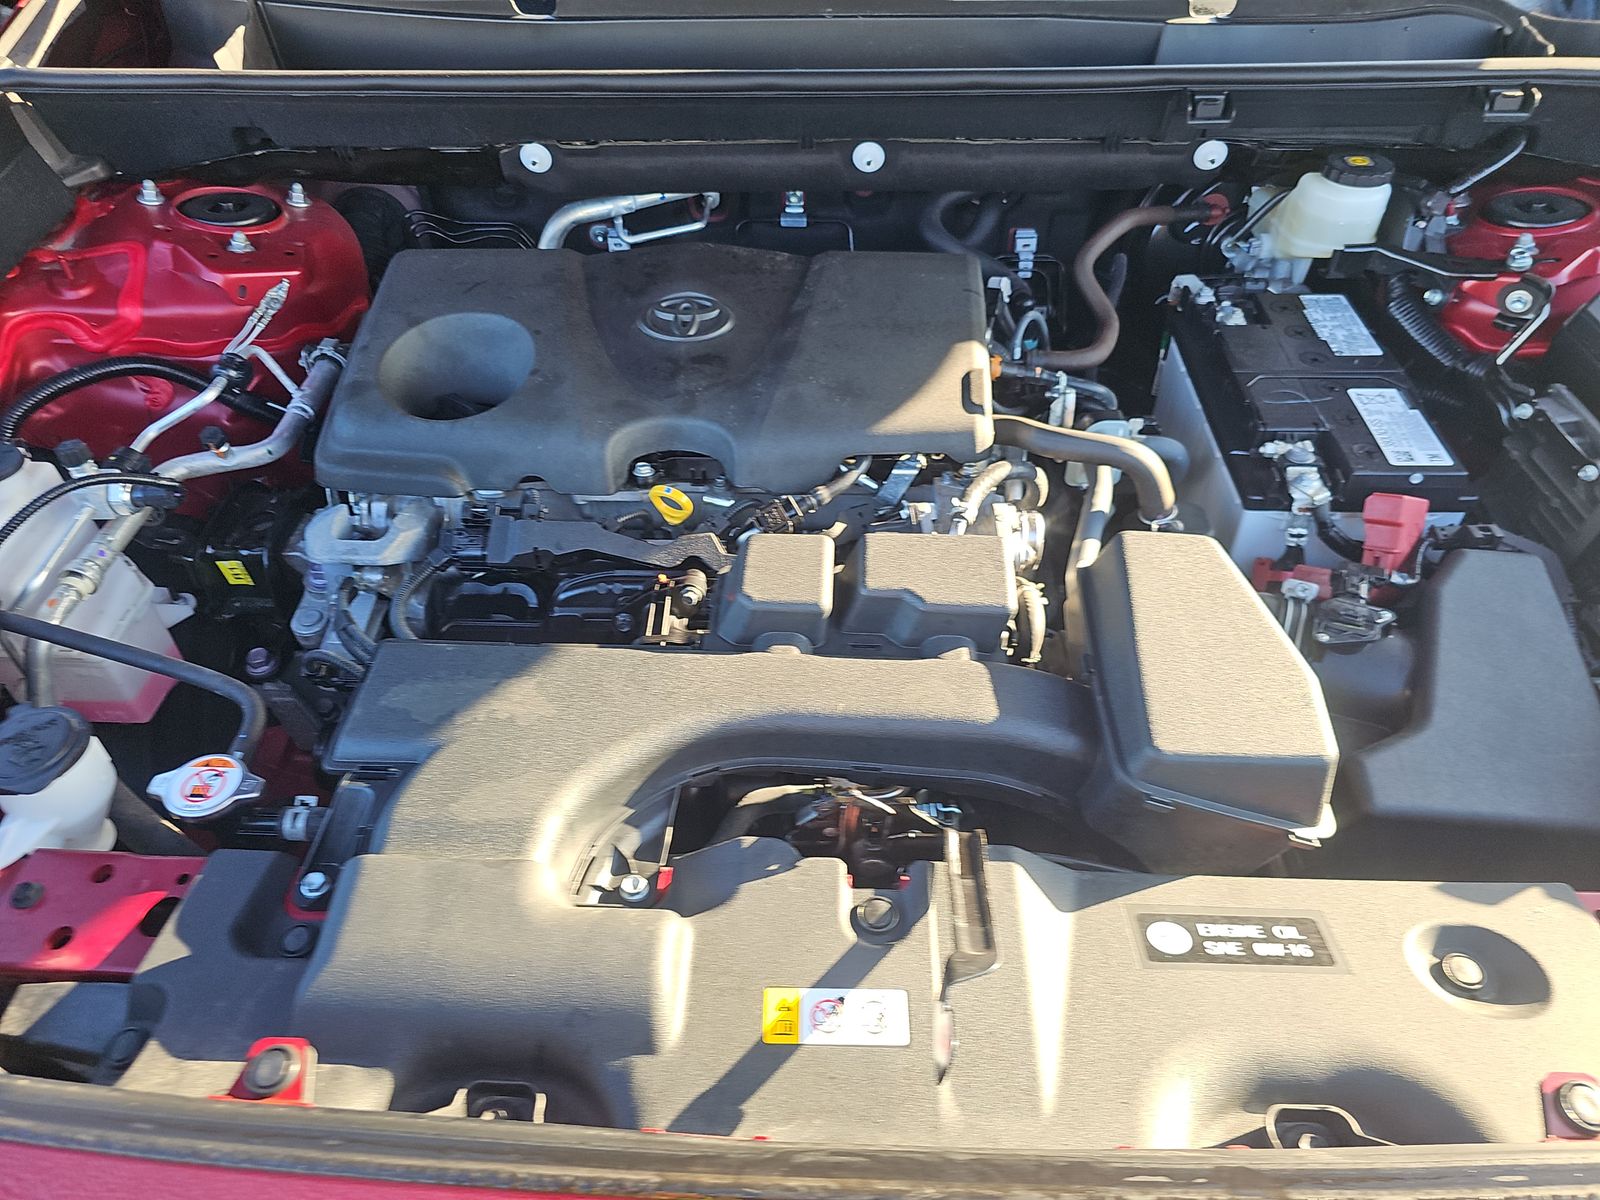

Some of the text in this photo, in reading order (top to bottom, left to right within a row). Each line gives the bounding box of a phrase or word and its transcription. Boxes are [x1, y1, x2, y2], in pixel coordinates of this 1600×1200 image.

[1195, 923, 1308, 940] ENGINE OIL
[1203, 940, 1246, 956] SAE
